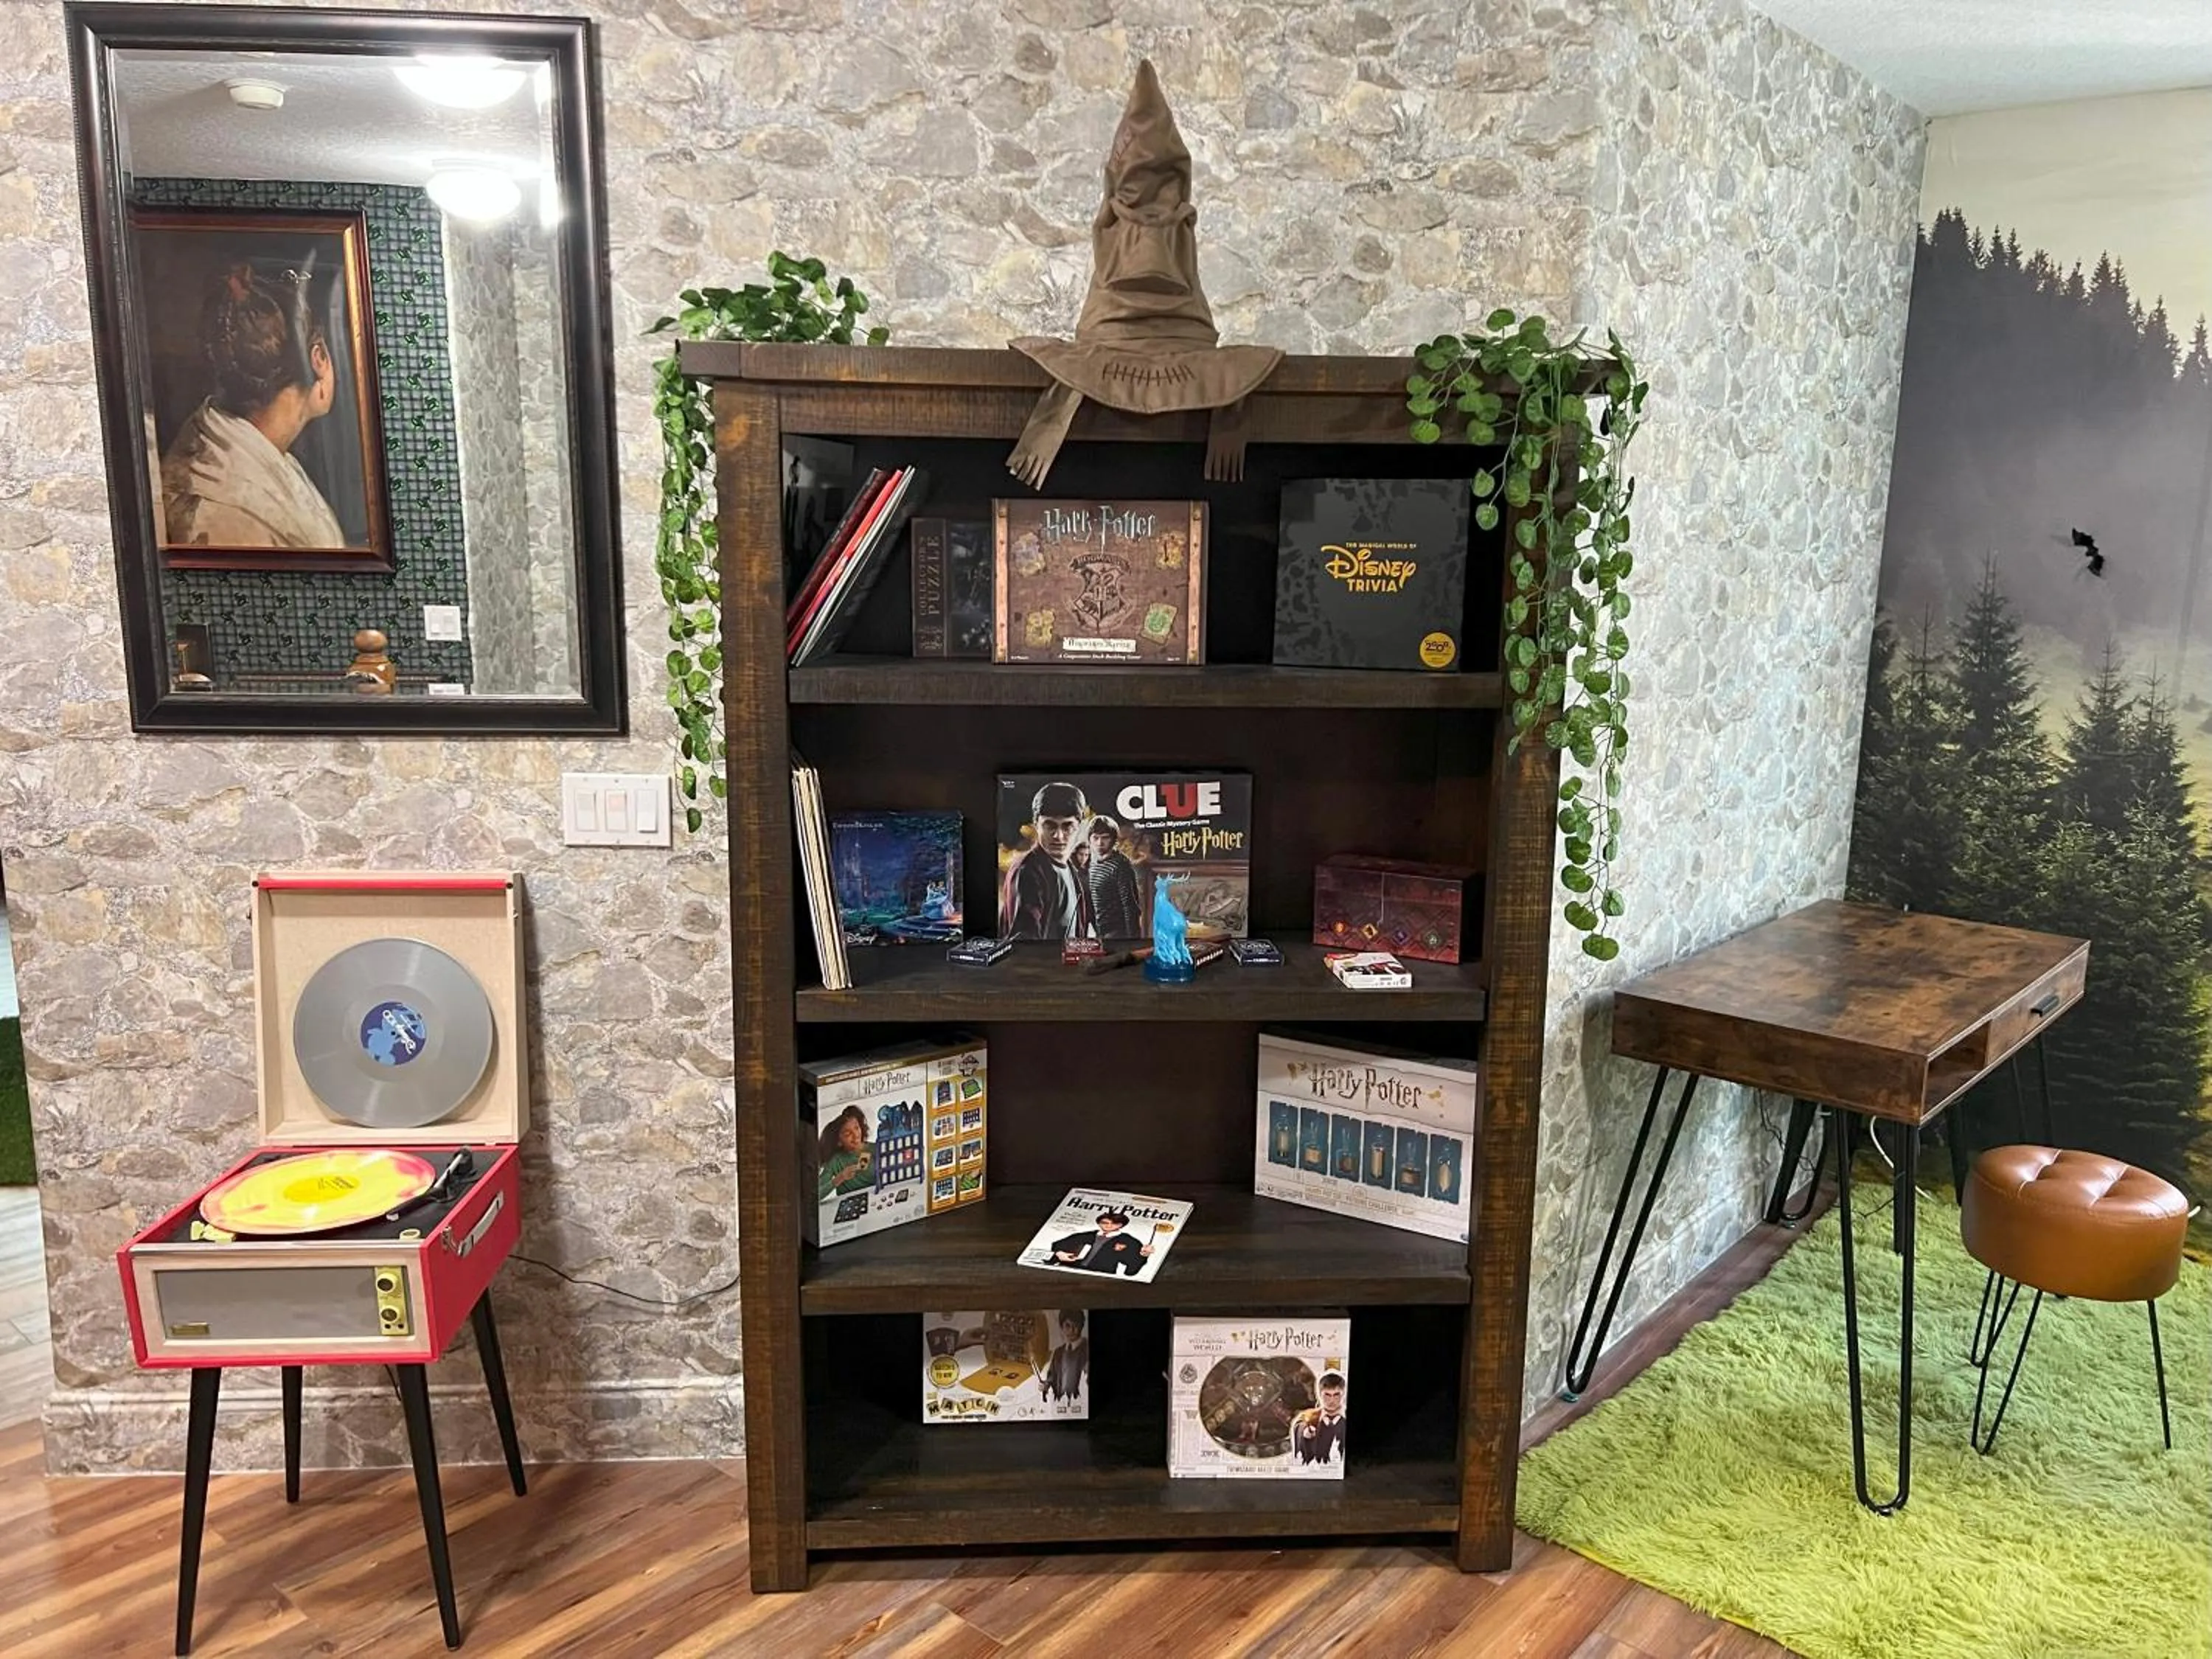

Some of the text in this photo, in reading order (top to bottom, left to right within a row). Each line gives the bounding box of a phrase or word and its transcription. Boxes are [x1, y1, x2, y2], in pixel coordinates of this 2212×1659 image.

[1042, 505, 1155, 554] Harry Potter
[928, 536, 940, 614] PUZZLE
[1347, 579, 1397, 592] TRIVIA
[1116, 782, 1221, 820] CLUE
[1161, 827, 1244, 859] Harry Potter
[862, 1076, 885, 1094] Harry
[886, 1071, 911, 1093] Potter
[1309, 1062, 1422, 1109] Harry Potter
[1067, 1197, 1119, 1214] Harry
[1120, 1204, 1179, 1221] Potter
[1248, 1326, 1324, 1352] Harry Potter
[928, 1397, 1000, 1416] MATCH
